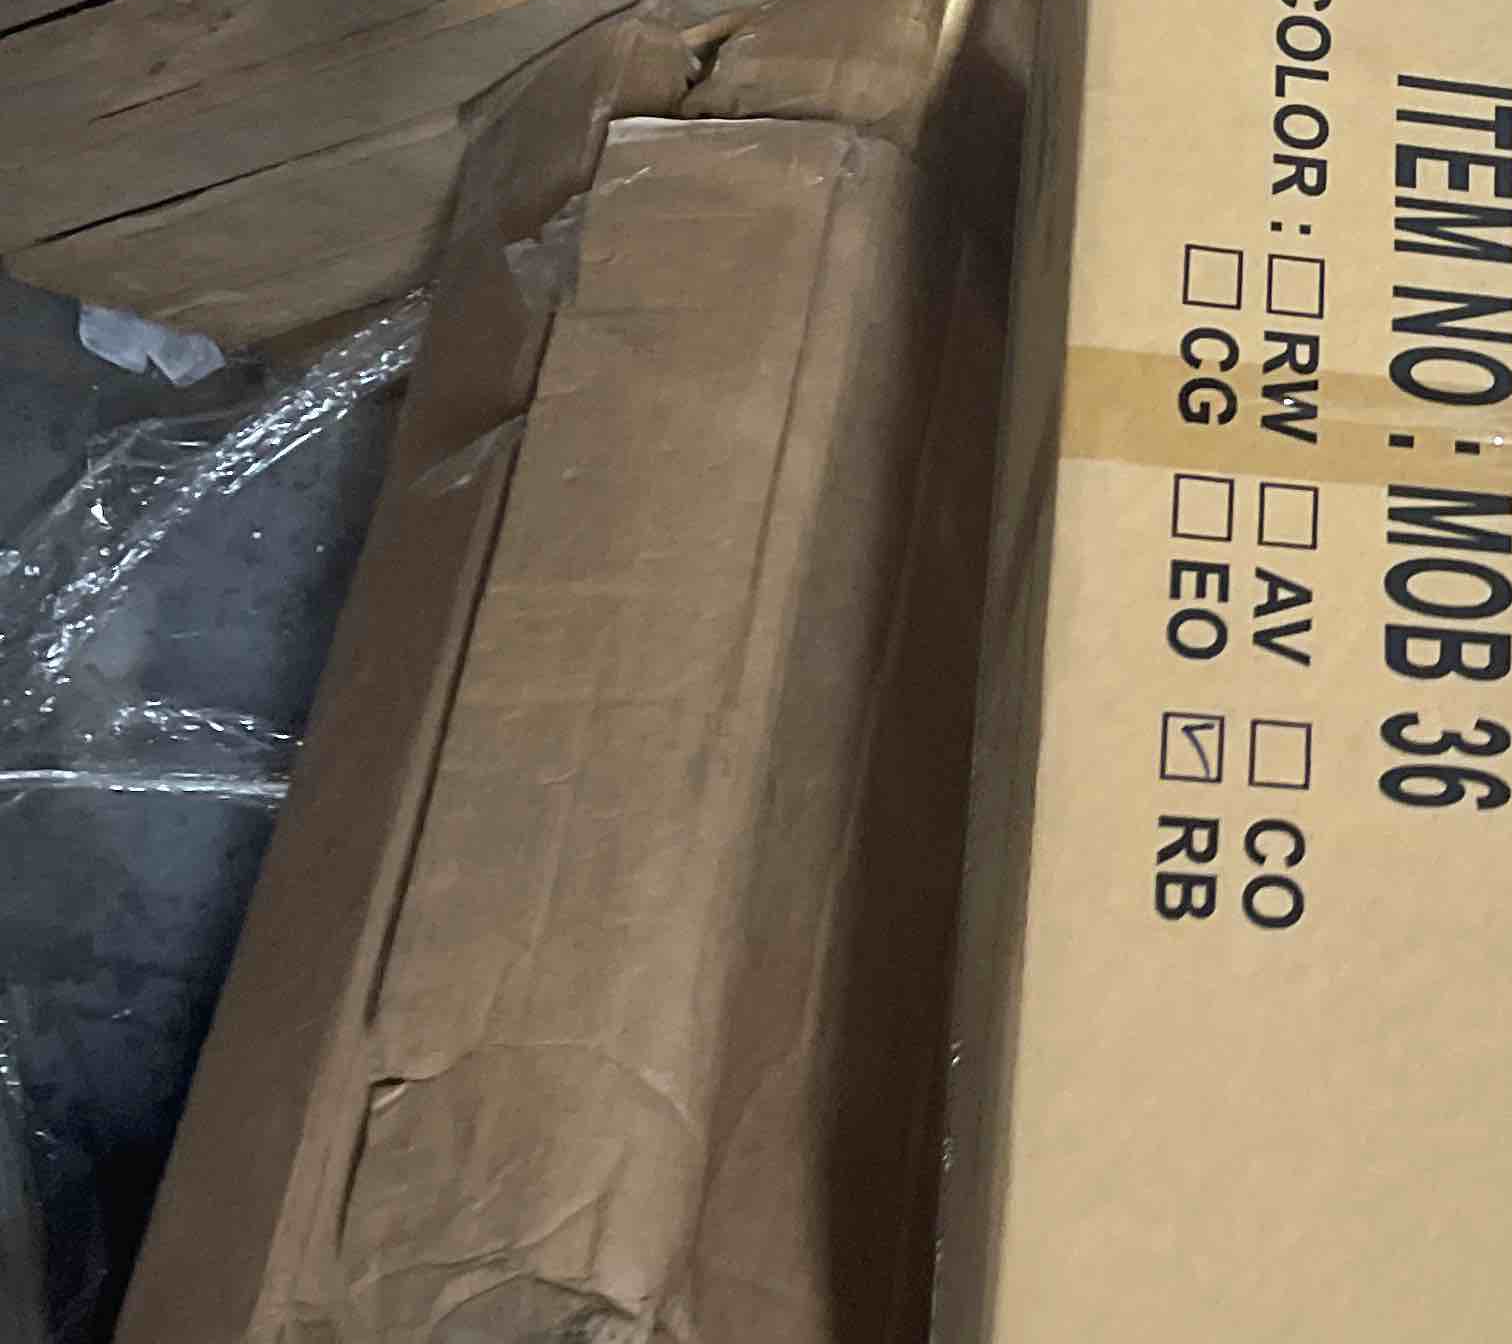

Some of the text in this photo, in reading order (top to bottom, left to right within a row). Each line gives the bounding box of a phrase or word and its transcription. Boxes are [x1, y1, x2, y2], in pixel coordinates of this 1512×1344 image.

[1260, 329, 1320, 445] RW
[1154, 326, 1241, 922] CG EO RB
[1253, 566, 1313, 668] AV
[1378, 711, 1512, 811] 36
[1242, 817, 1306, 930] CO
